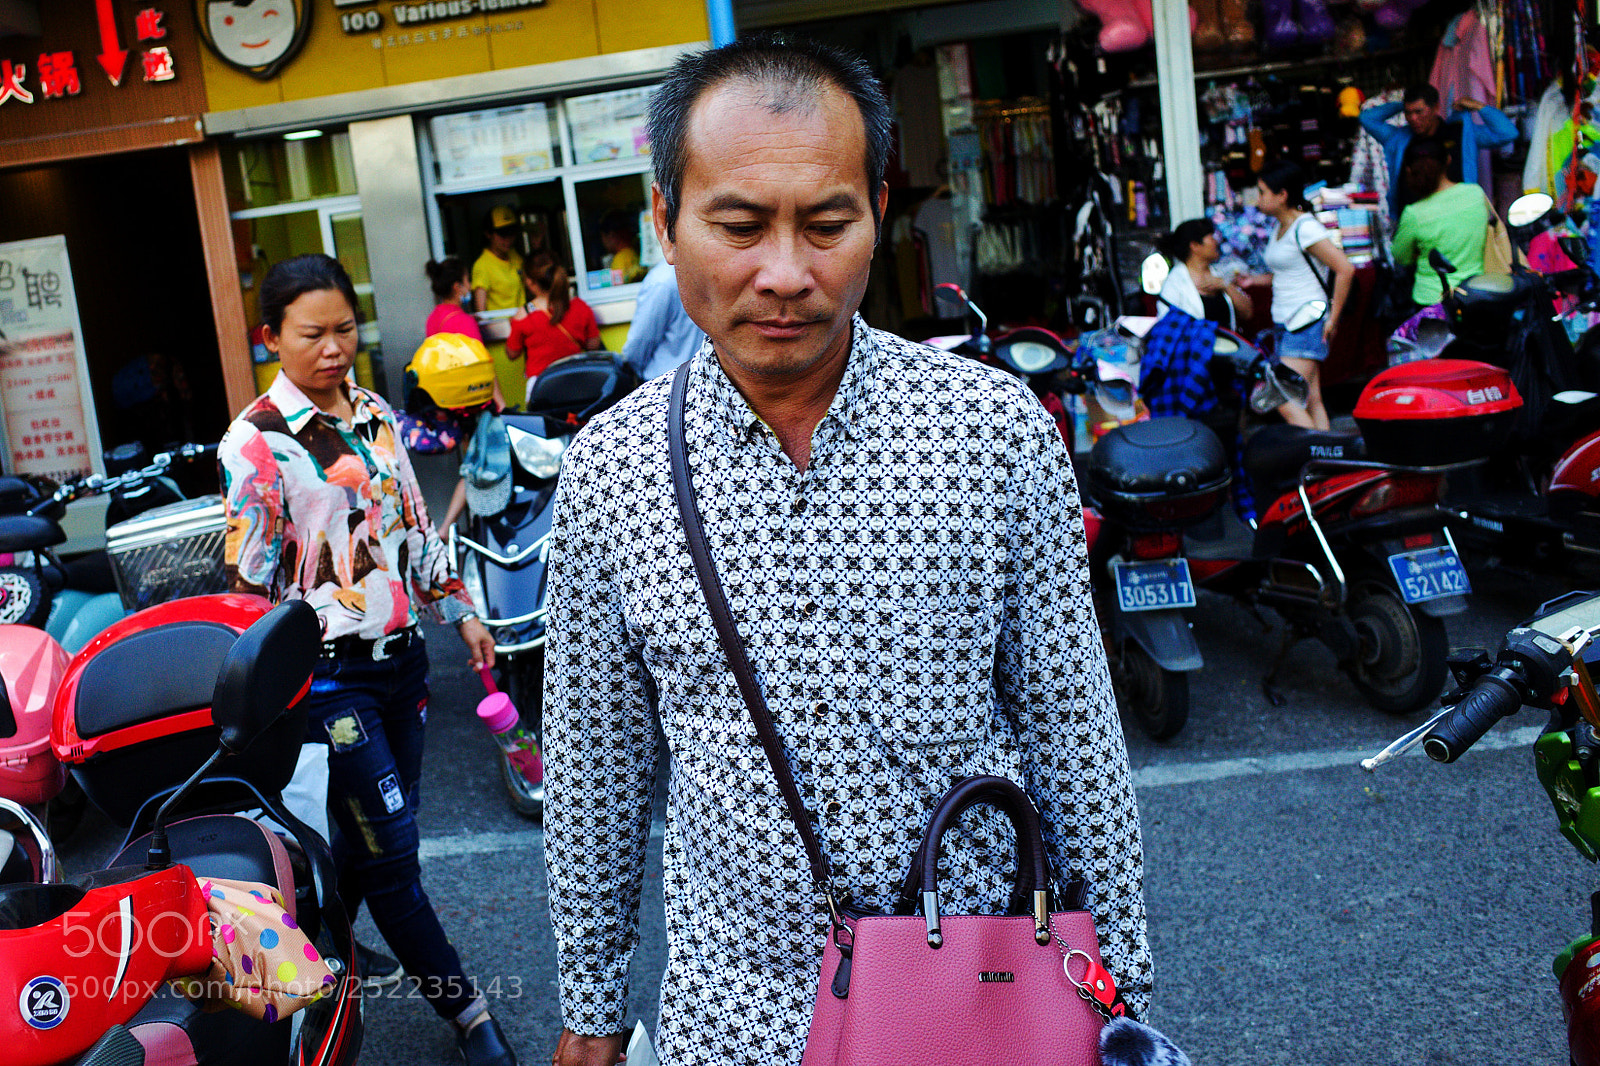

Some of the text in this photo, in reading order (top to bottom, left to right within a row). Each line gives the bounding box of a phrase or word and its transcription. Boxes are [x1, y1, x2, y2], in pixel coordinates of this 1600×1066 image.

[342, 0, 543, 31] 100 Various-lem
[1310, 445, 1343, 457] TAILG
[1122, 582, 1189, 607] 305317
